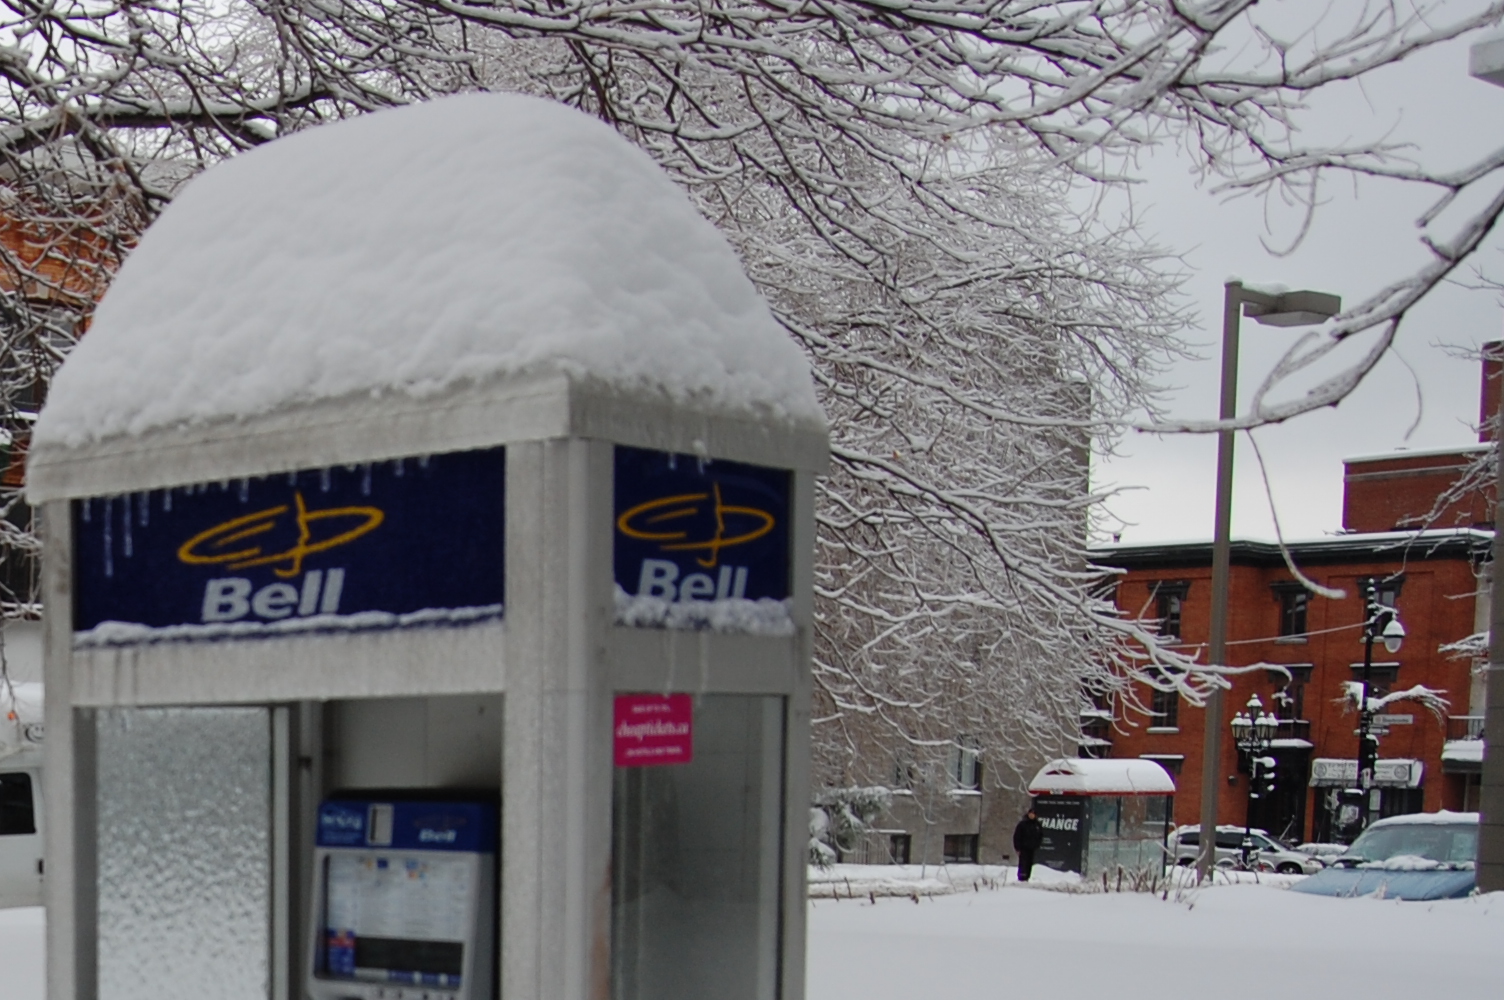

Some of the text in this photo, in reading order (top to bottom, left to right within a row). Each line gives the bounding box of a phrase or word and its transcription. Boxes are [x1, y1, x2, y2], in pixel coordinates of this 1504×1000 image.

[201, 568, 345, 622] Bell
[638, 558, 748, 602] Bell
[1037, 817, 1079, 831] HANGE
